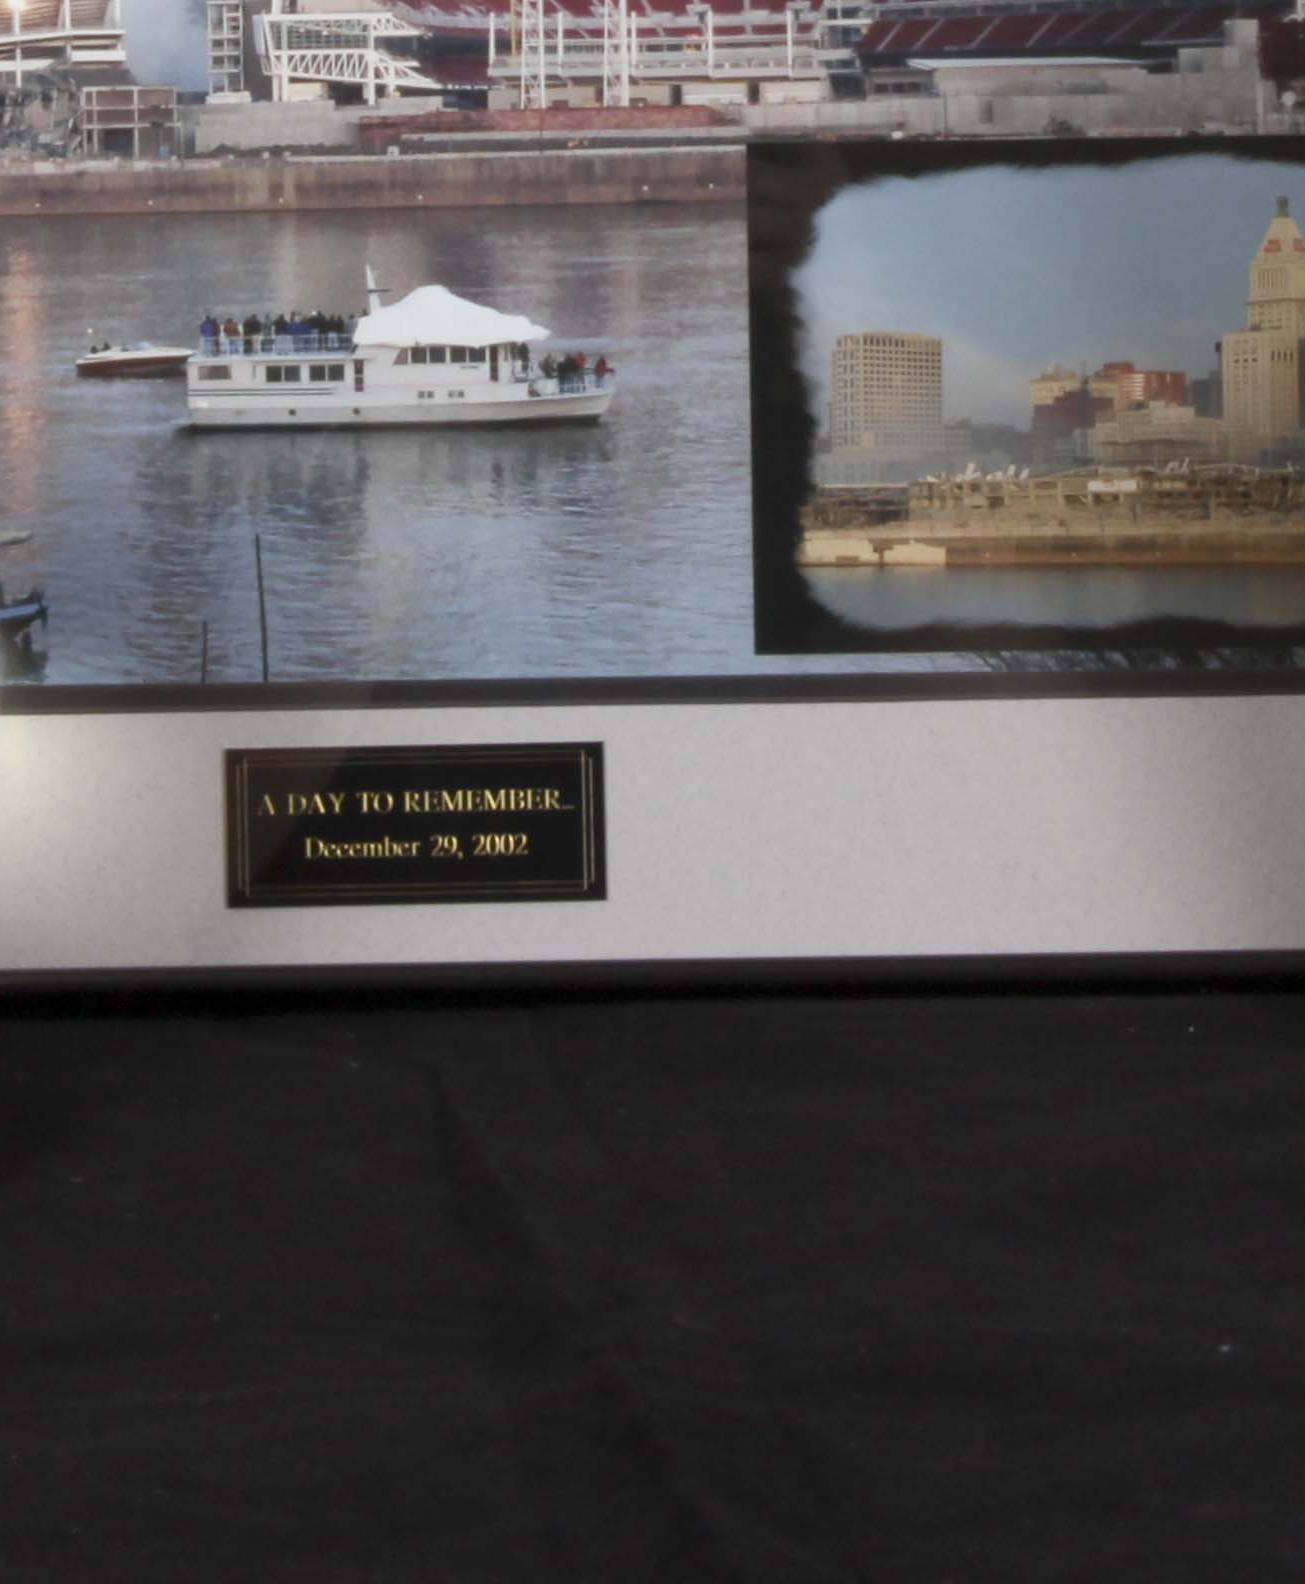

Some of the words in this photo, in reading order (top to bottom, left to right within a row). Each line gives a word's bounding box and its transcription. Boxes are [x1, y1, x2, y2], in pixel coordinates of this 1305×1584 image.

[257, 792, 277, 816] A
[287, 791, 347, 815] DAY
[355, 790, 395, 814] TO
[303, 836, 422, 859] December
[429, 834, 464, 860] 29,
[472, 832, 529, 857] 2002
